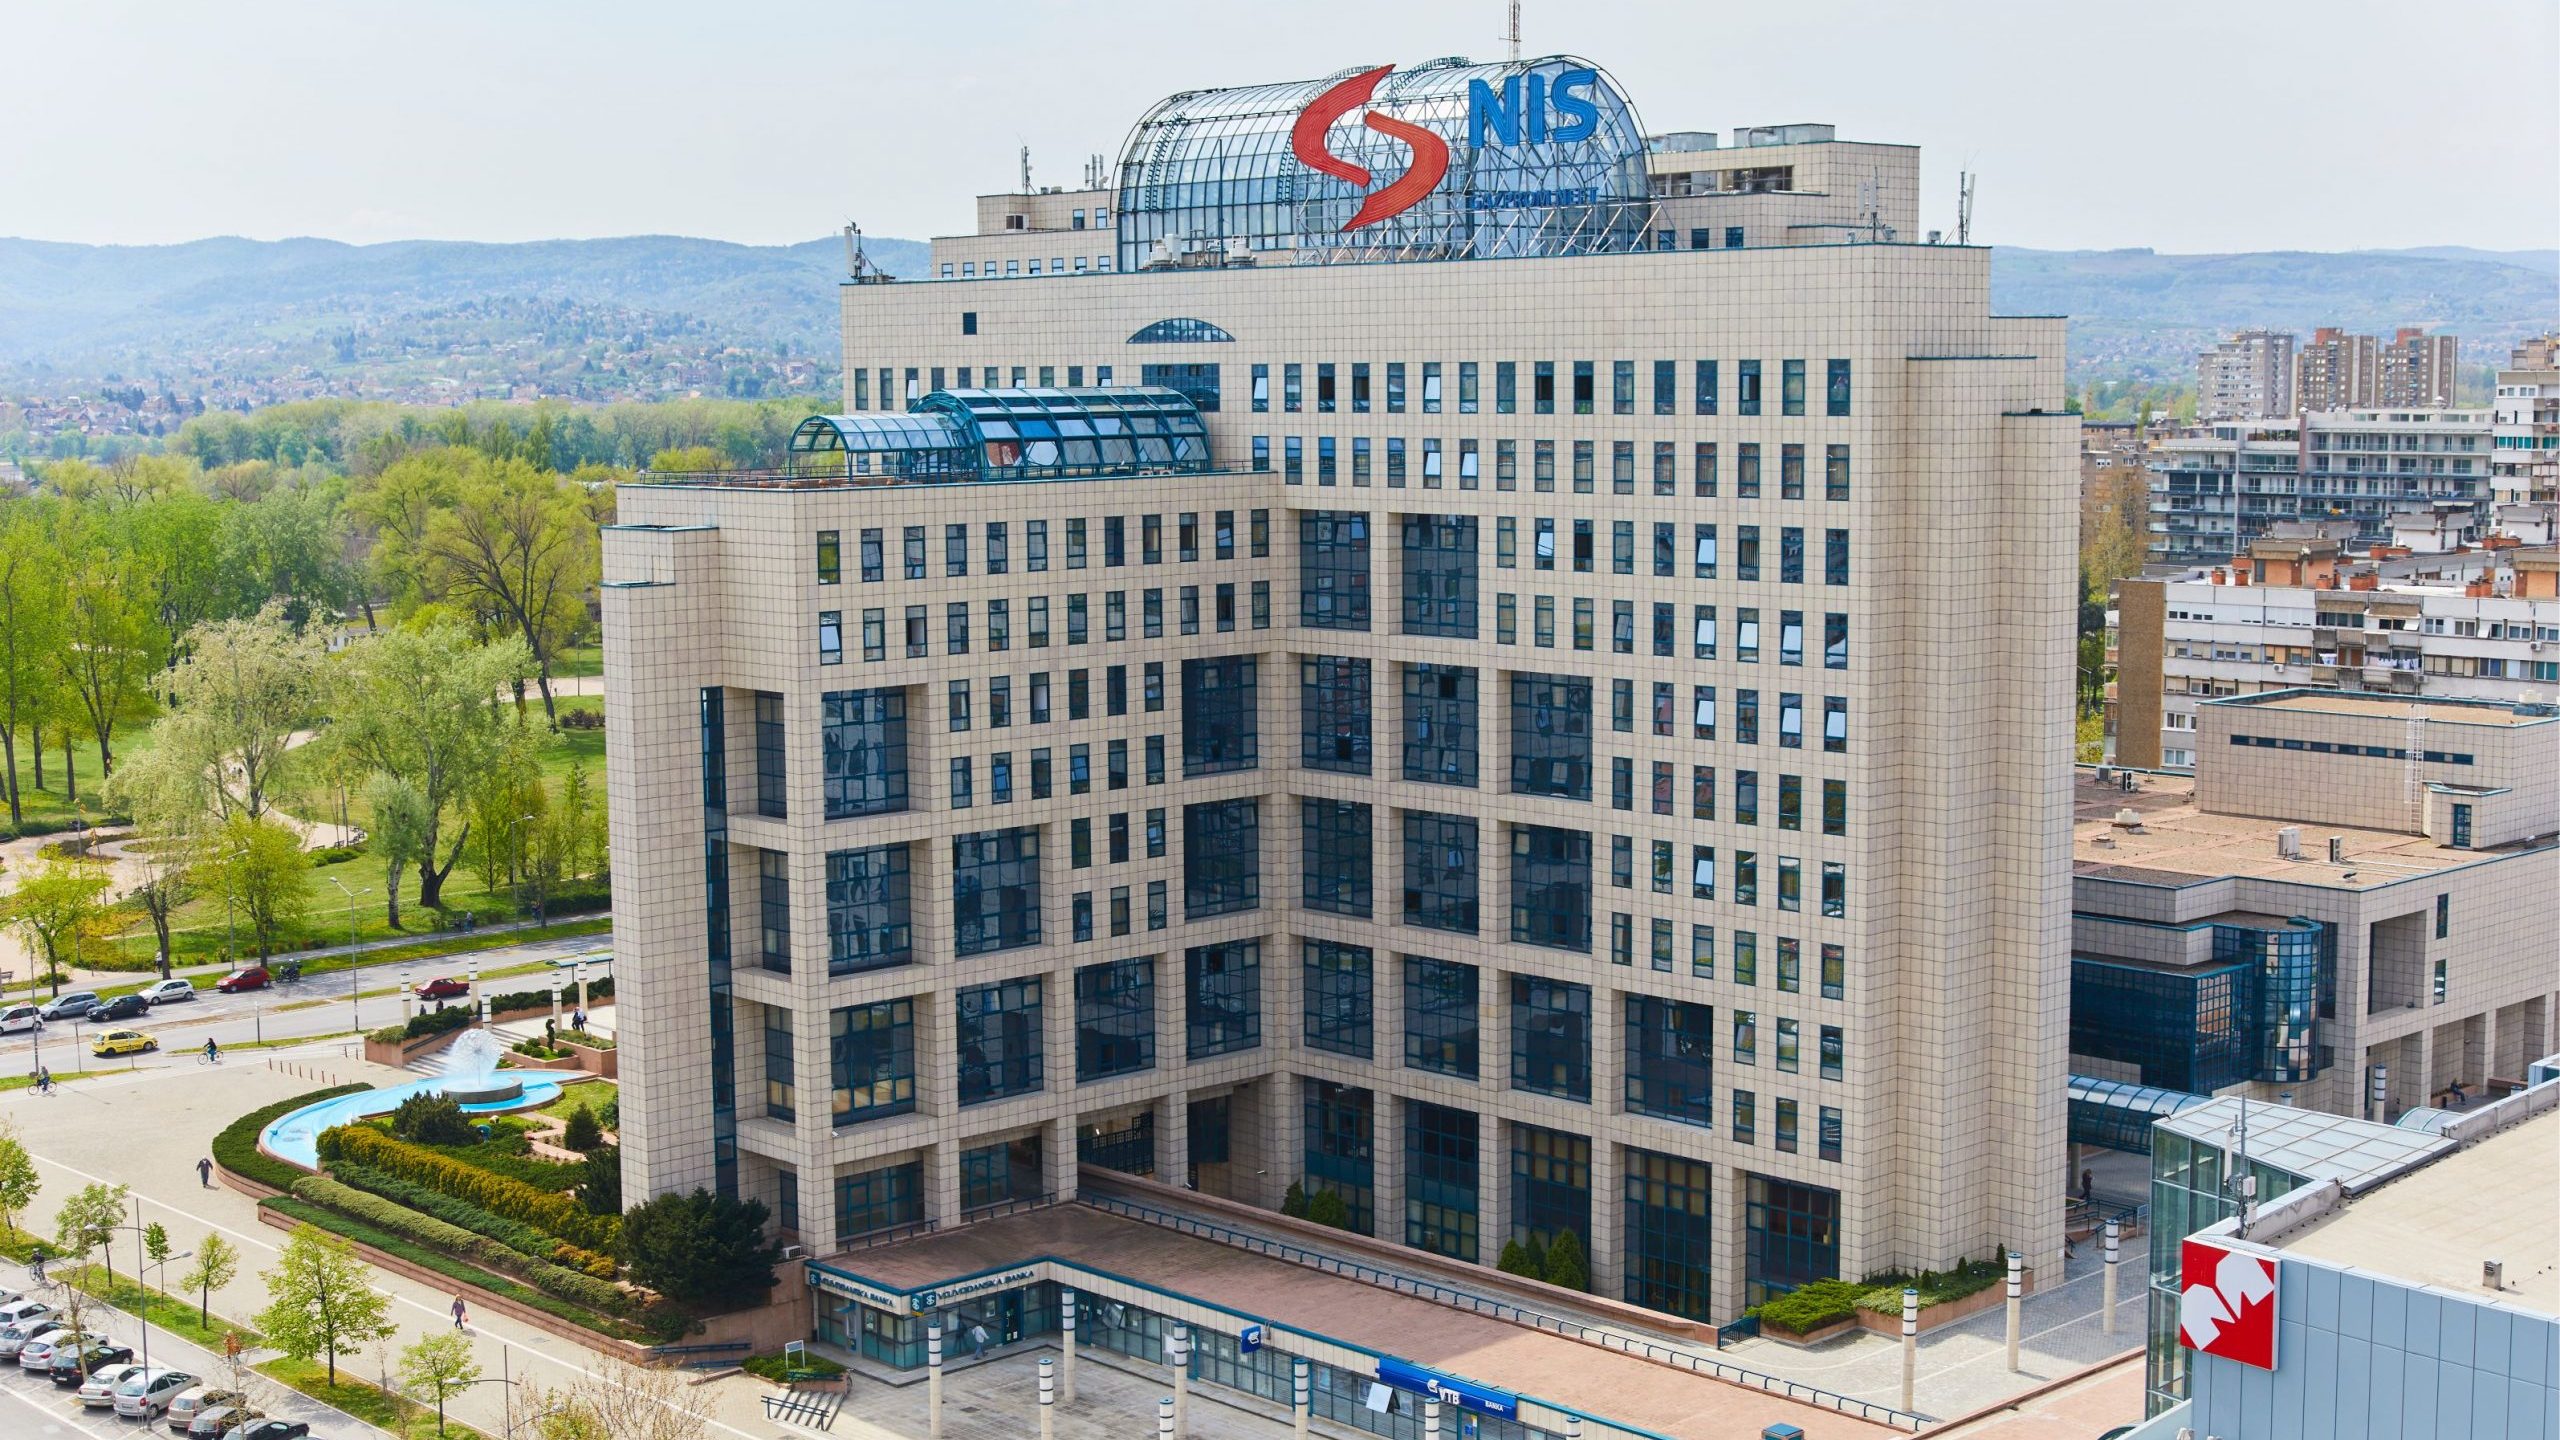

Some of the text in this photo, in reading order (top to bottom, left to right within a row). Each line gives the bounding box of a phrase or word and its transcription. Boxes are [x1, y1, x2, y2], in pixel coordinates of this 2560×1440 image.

[1469, 68, 1597, 148] NIS
[1439, 1386, 1504, 1412] VTB BANKA
